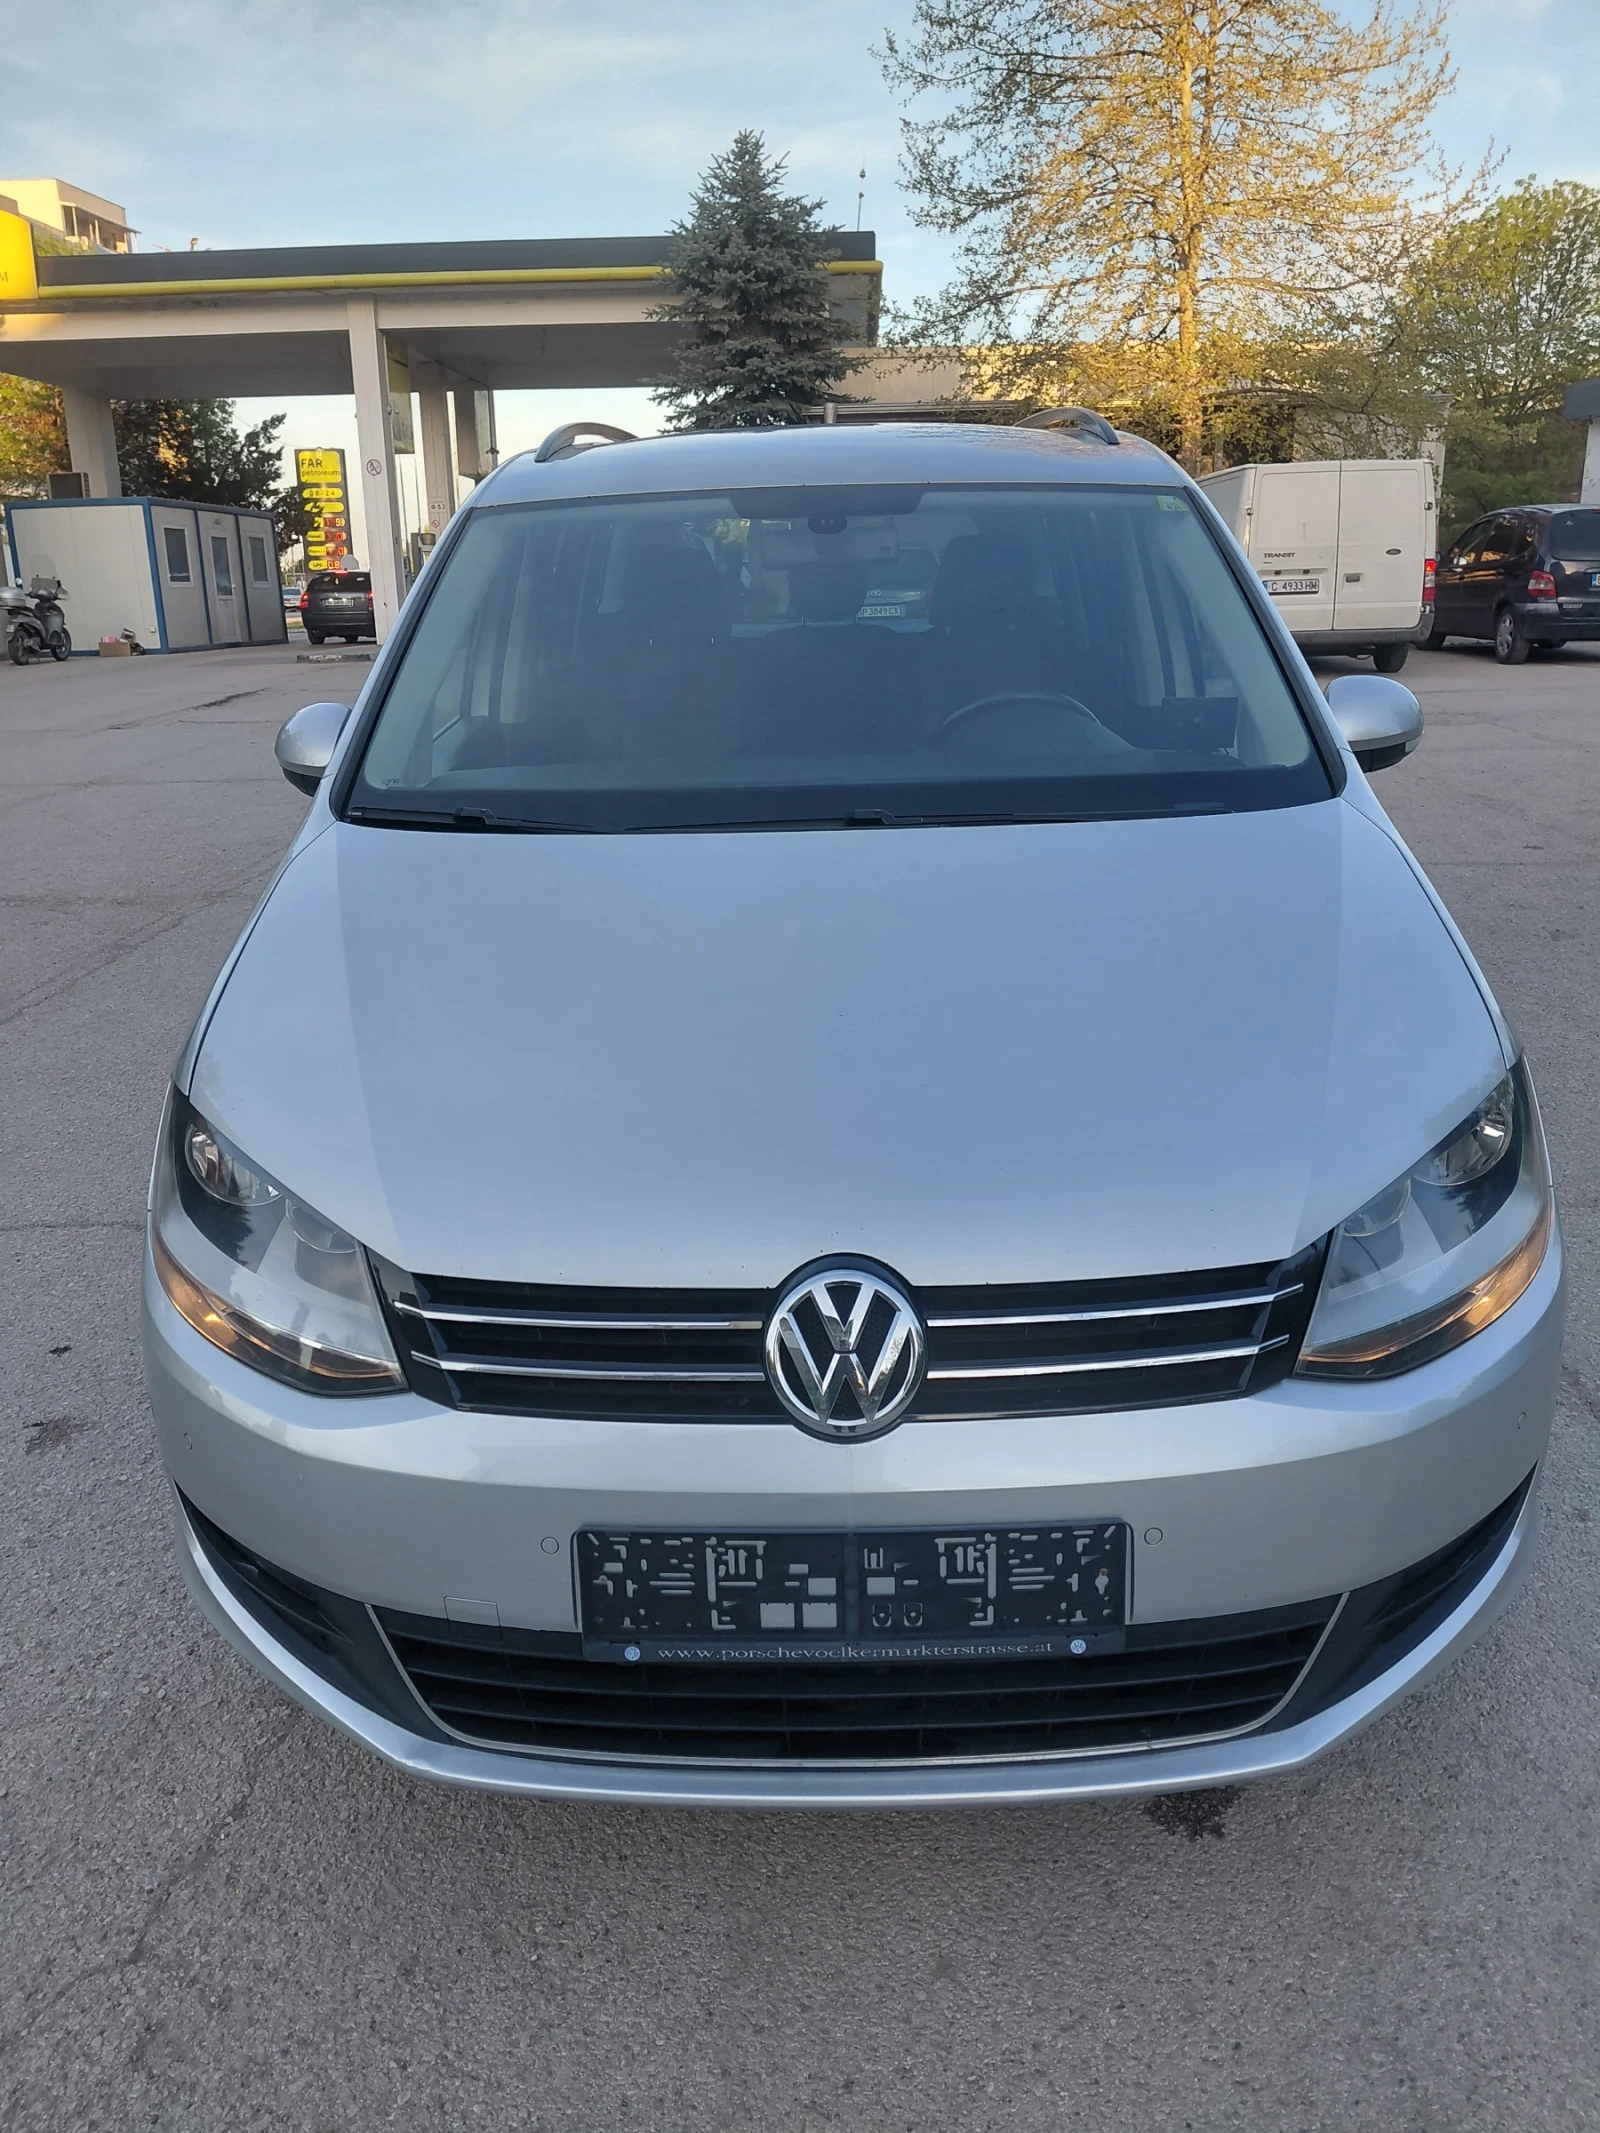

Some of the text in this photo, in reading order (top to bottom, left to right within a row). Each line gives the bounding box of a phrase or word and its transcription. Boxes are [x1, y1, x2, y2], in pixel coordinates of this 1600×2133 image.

[300, 458, 323, 468] FAR
[301, 469, 340, 477] petroleum
[1271, 582, 1278, 591] C
[1282, 581, 1303, 590] 4933
